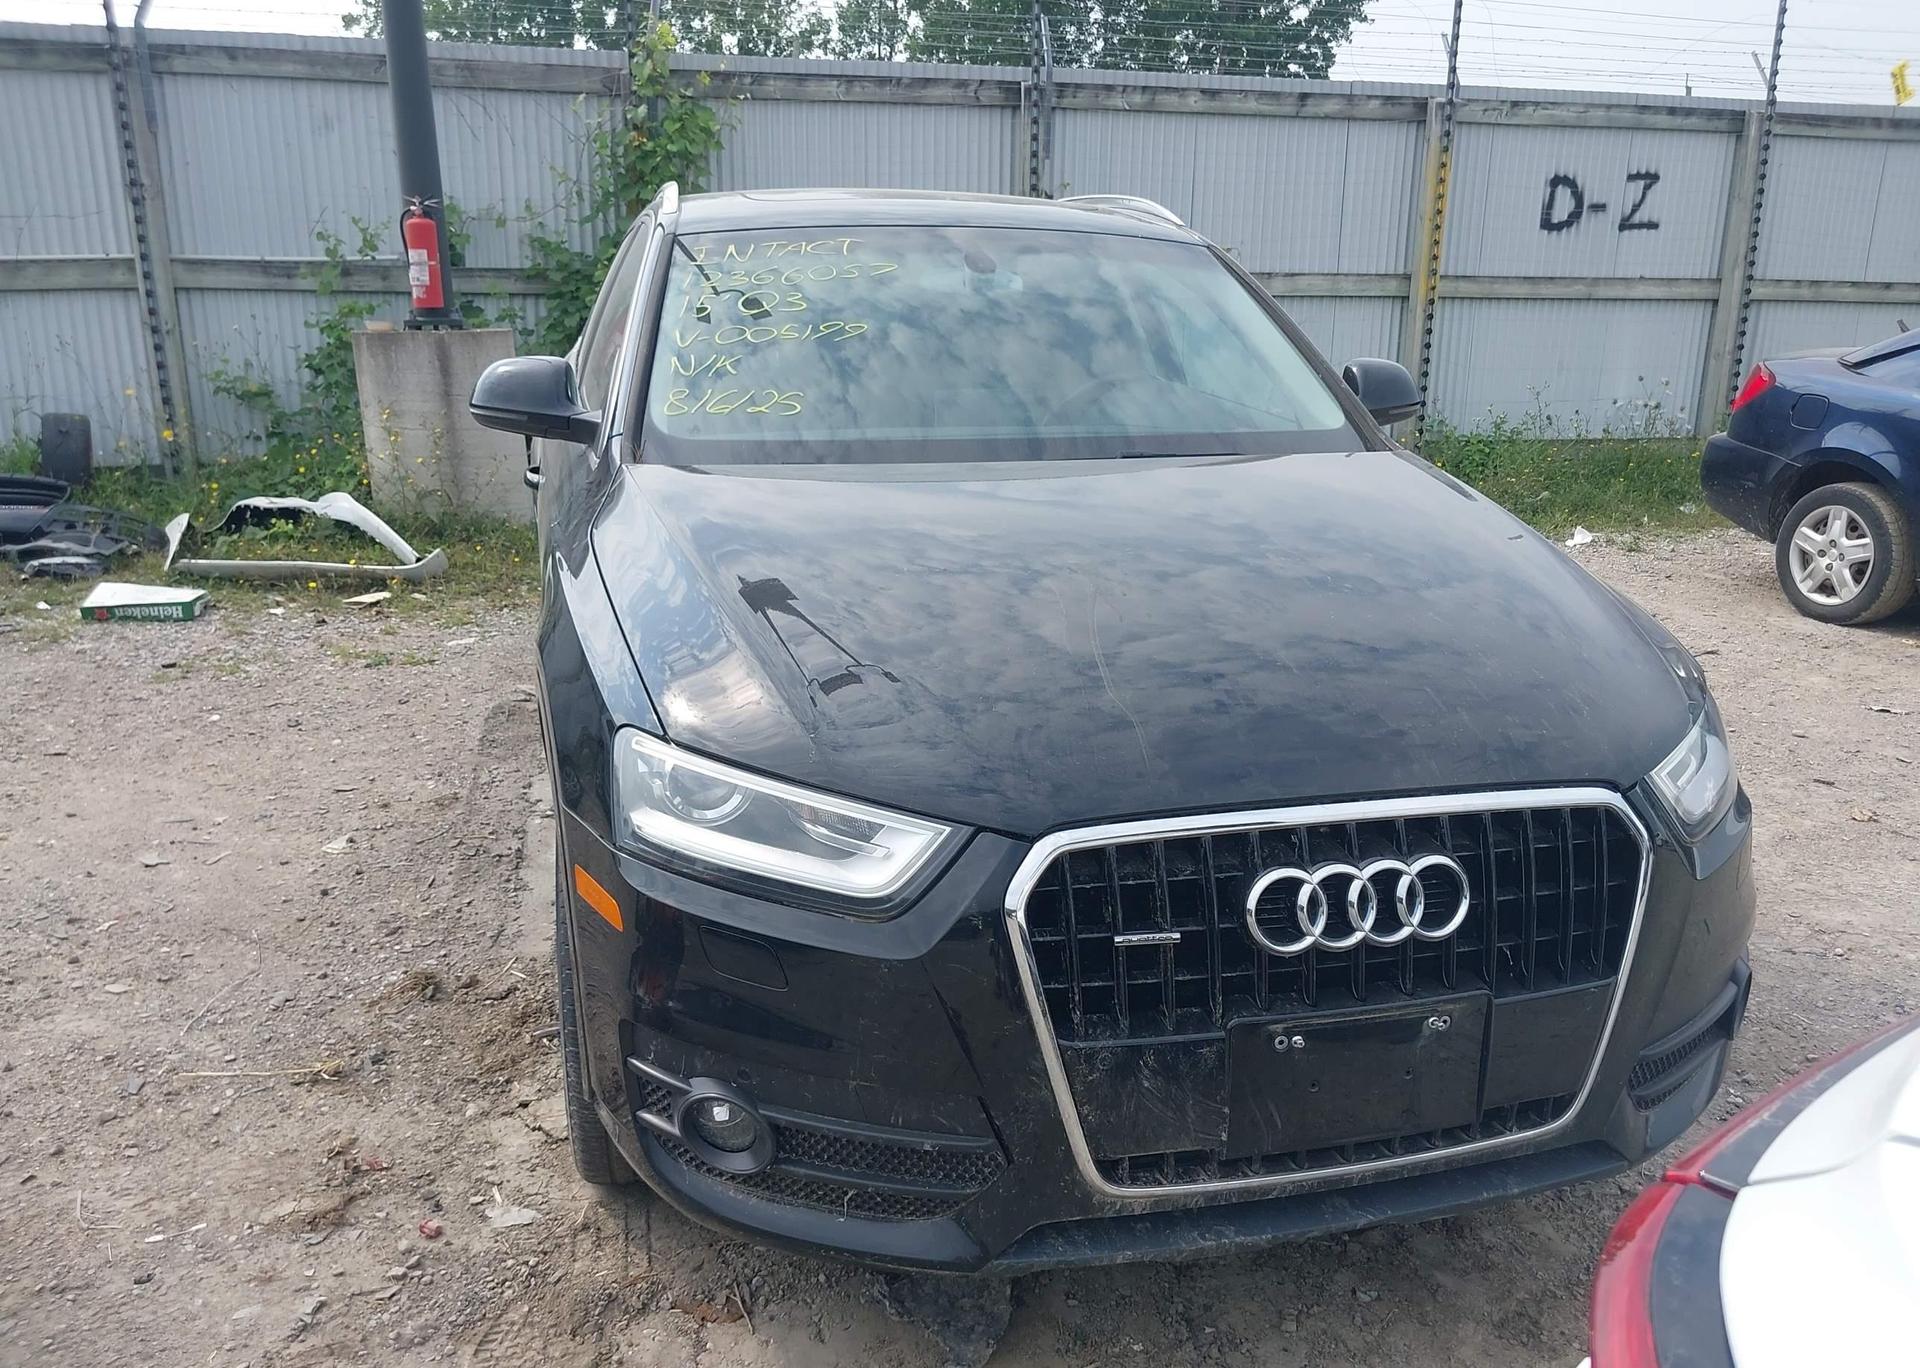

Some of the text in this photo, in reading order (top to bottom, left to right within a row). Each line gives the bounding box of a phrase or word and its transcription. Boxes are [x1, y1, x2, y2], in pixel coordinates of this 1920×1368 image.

[690, 238, 864, 265] INTACT
[737, 290, 808, 316] Q3
[664, 388, 805, 416] 8/6/25
[114, 605, 184, 619] Heineken
